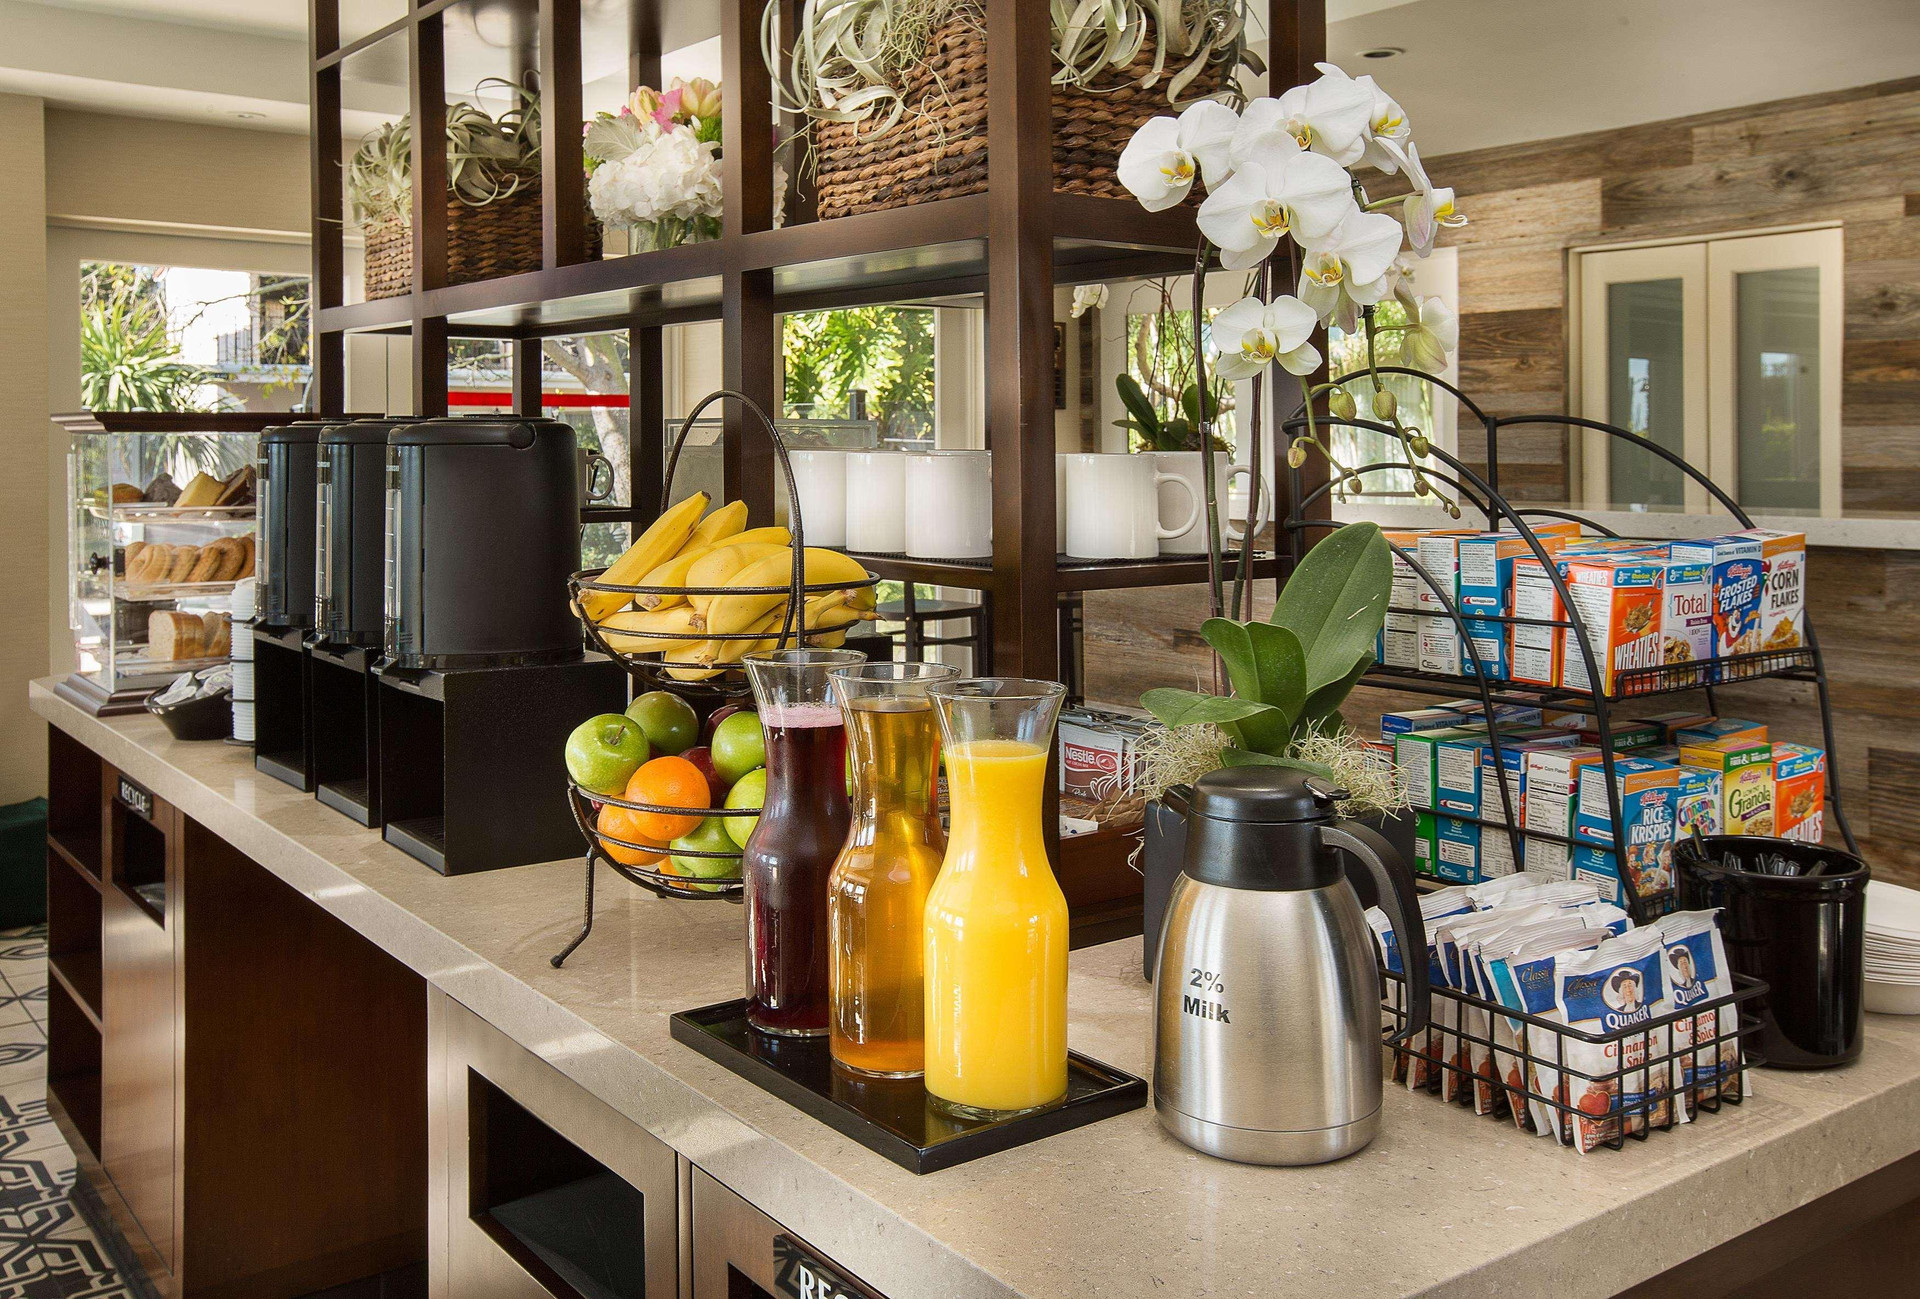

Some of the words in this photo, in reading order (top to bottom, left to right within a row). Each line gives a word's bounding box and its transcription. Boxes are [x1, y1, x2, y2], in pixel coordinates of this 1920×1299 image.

[1576, 570, 1608, 586] WHEATIES
[1719, 575, 1758, 601] FROSTED
[1772, 568, 1799, 590] CORN
[1674, 593, 1706, 616] Total
[1720, 589, 1753, 614] FLAKES
[1771, 588, 1799, 610] FLAKES
[1615, 632, 1658, 670] WHEATIES
[1741, 754, 1749, 764] &
[1640, 790, 1668, 806] Kellogg's
[1730, 785, 1771, 818] Granola
[1643, 806, 1664, 826] RICE
[1631, 820, 1672, 844] KRISPIES
[1190, 968, 1224, 993] 2%
[1674, 980, 1705, 1006] QUAKER
[1184, 995, 1231, 1024] Milk
[1606, 1005, 1650, 1030] QUAKER
[1626, 1053, 1653, 1068] Spie
